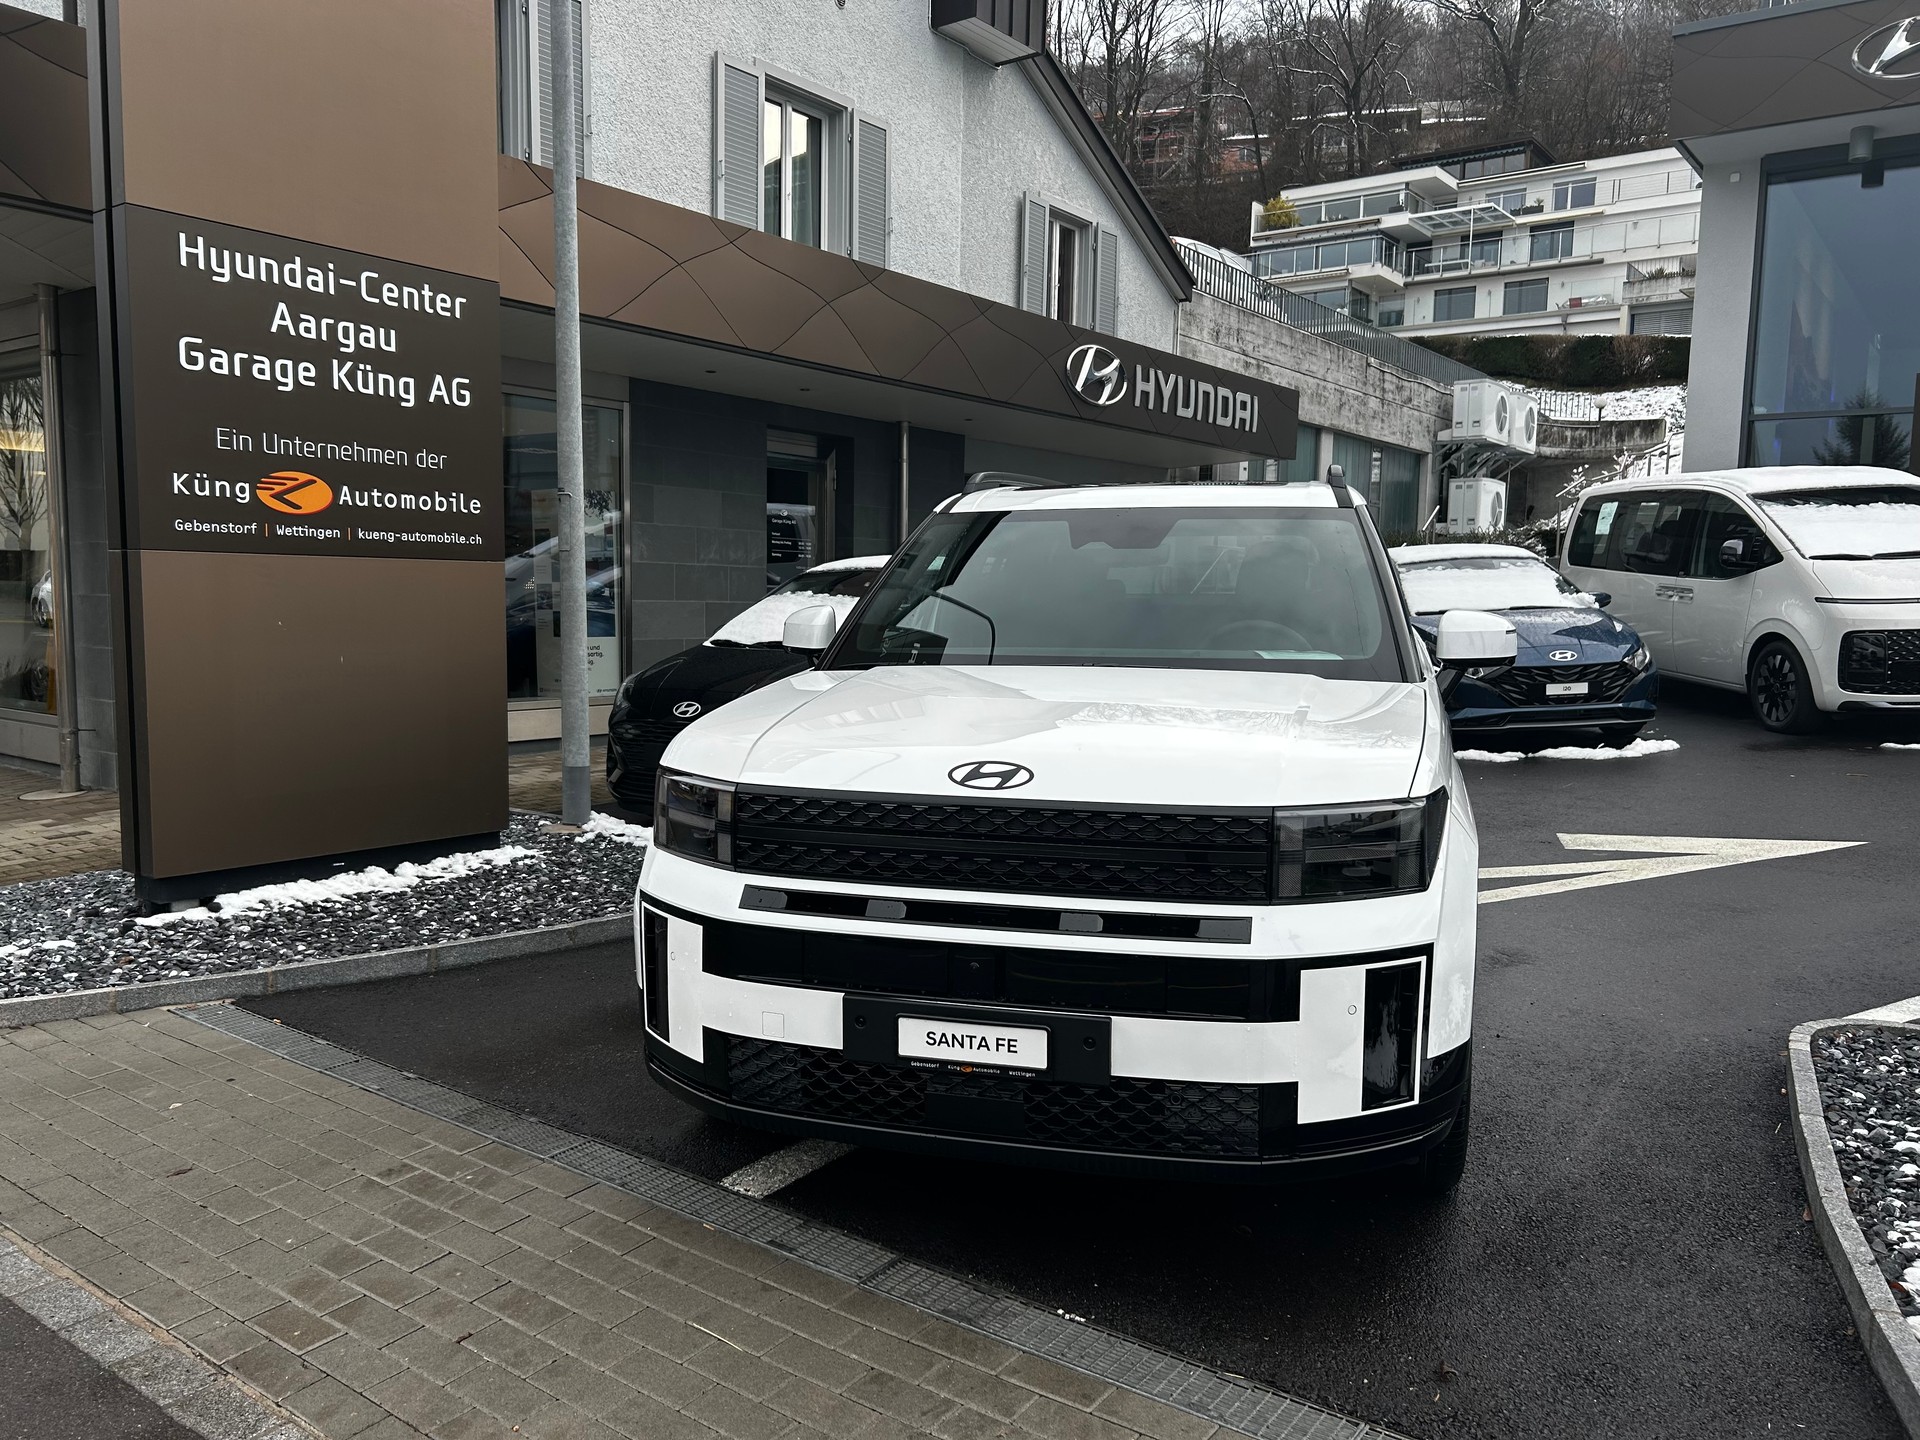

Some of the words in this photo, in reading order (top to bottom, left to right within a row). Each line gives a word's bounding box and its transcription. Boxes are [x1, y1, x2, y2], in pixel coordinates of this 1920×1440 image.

[178, 231, 467, 319] Hyundai-Center
[270, 301, 397, 354] Aargau
[178, 336, 316, 392] Garage
[332, 358, 415, 408] Küng
[428, 374, 471, 407] AG
[1134, 364, 1259, 433] HYUNDAI
[216, 427, 253, 452] Ein
[262, 432, 408, 466] Unternehmen
[416, 448, 448, 470] der
[172, 472, 250, 504] Küng
[338, 485, 481, 514] Automobile
[174, 518, 258, 535] Gebenstorf
[276, 524, 341, 540] Wettingen
[358, 527, 482, 545] kueng-automobile.ch
[925, 1031, 991, 1052] SANTA
[995, 1037, 1018, 1054] FE
